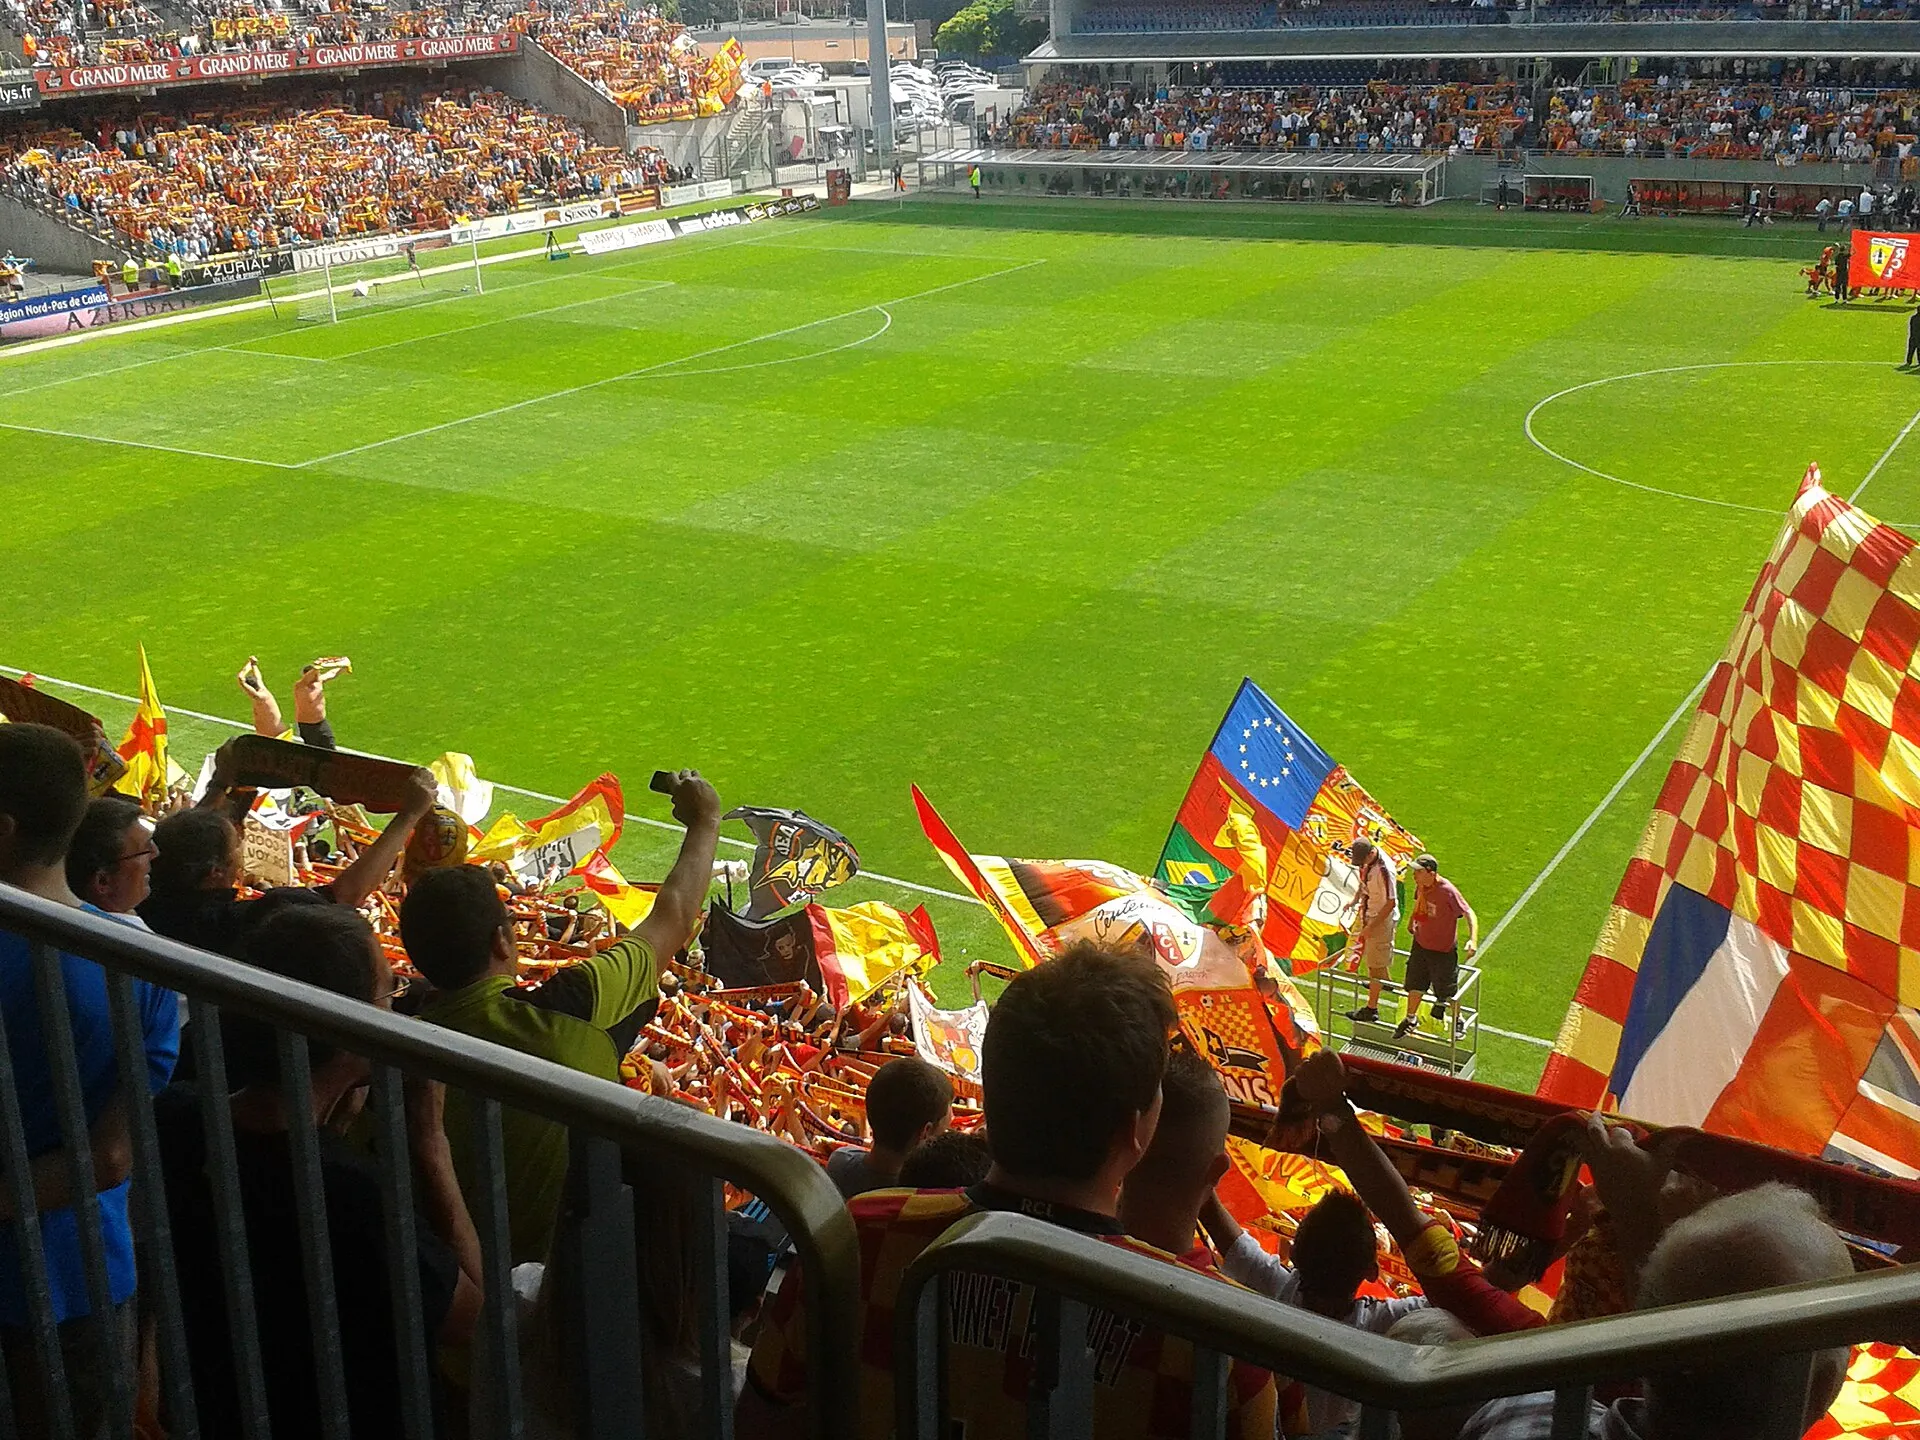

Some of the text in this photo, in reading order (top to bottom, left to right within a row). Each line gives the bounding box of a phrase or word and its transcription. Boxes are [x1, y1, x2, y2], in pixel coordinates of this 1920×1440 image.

[203, 257, 269, 278] AZURIAL
[25, 299, 68, 316] Nord-Pas
[69, 296, 81, 307] de
[81, 291, 109, 305] Calais
[1155, 924, 1179, 960] RCL
[1022, 1198, 1054, 1218] RCL
